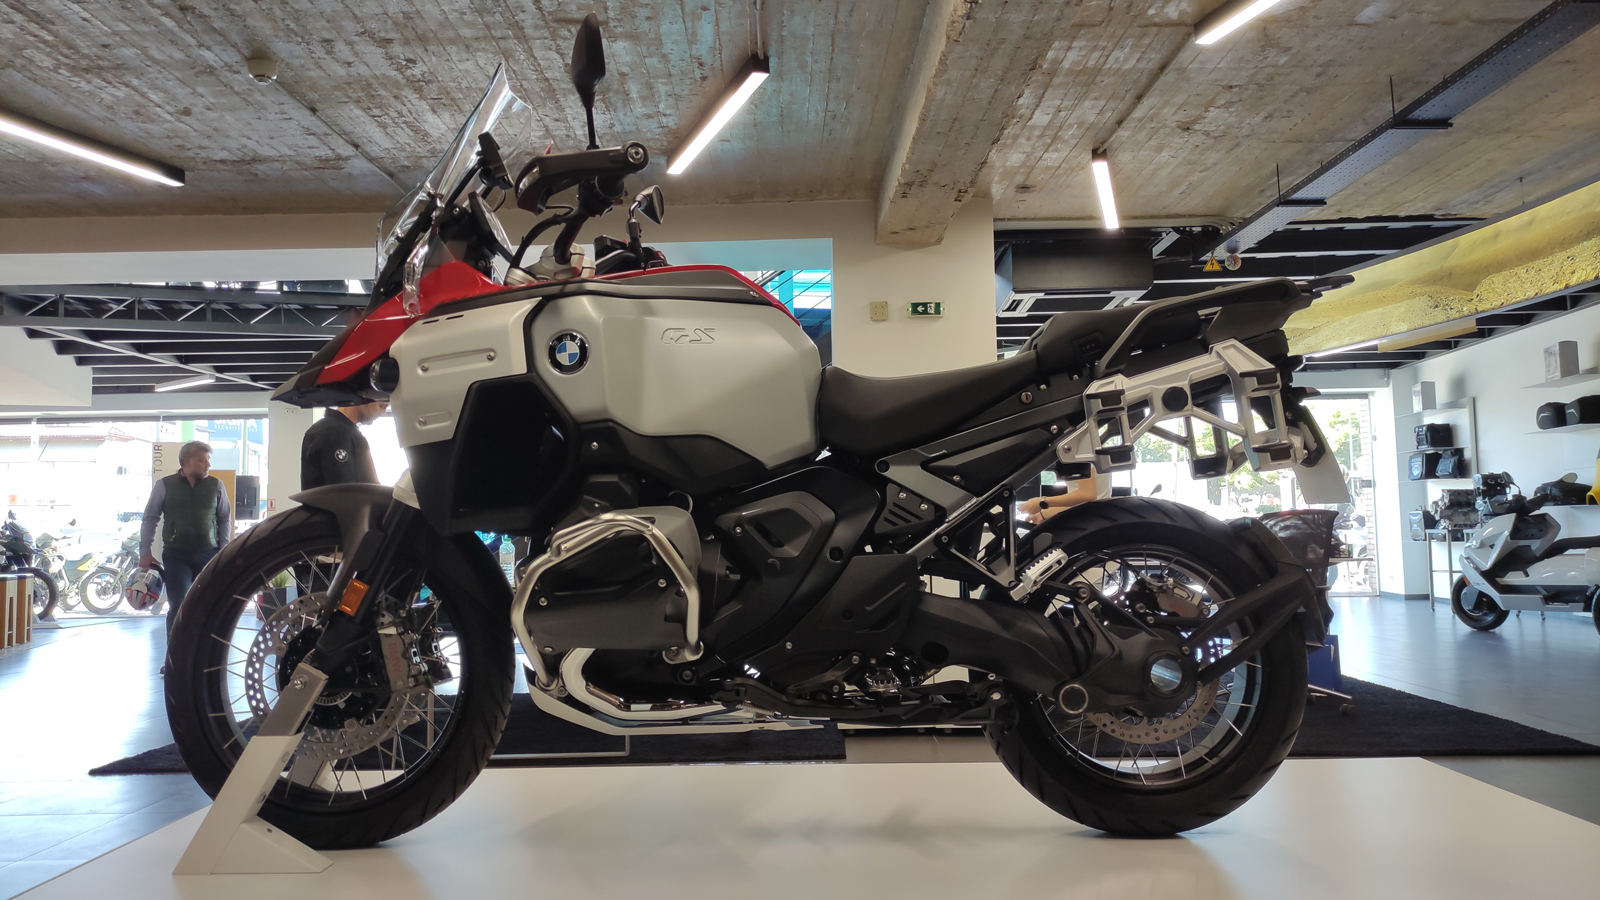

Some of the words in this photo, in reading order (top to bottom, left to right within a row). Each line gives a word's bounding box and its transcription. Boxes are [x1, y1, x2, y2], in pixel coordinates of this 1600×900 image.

[660, 327, 716, 344] GS
[154, 444, 163, 473] TOUR
[388, 642, 402, 672] BMW
